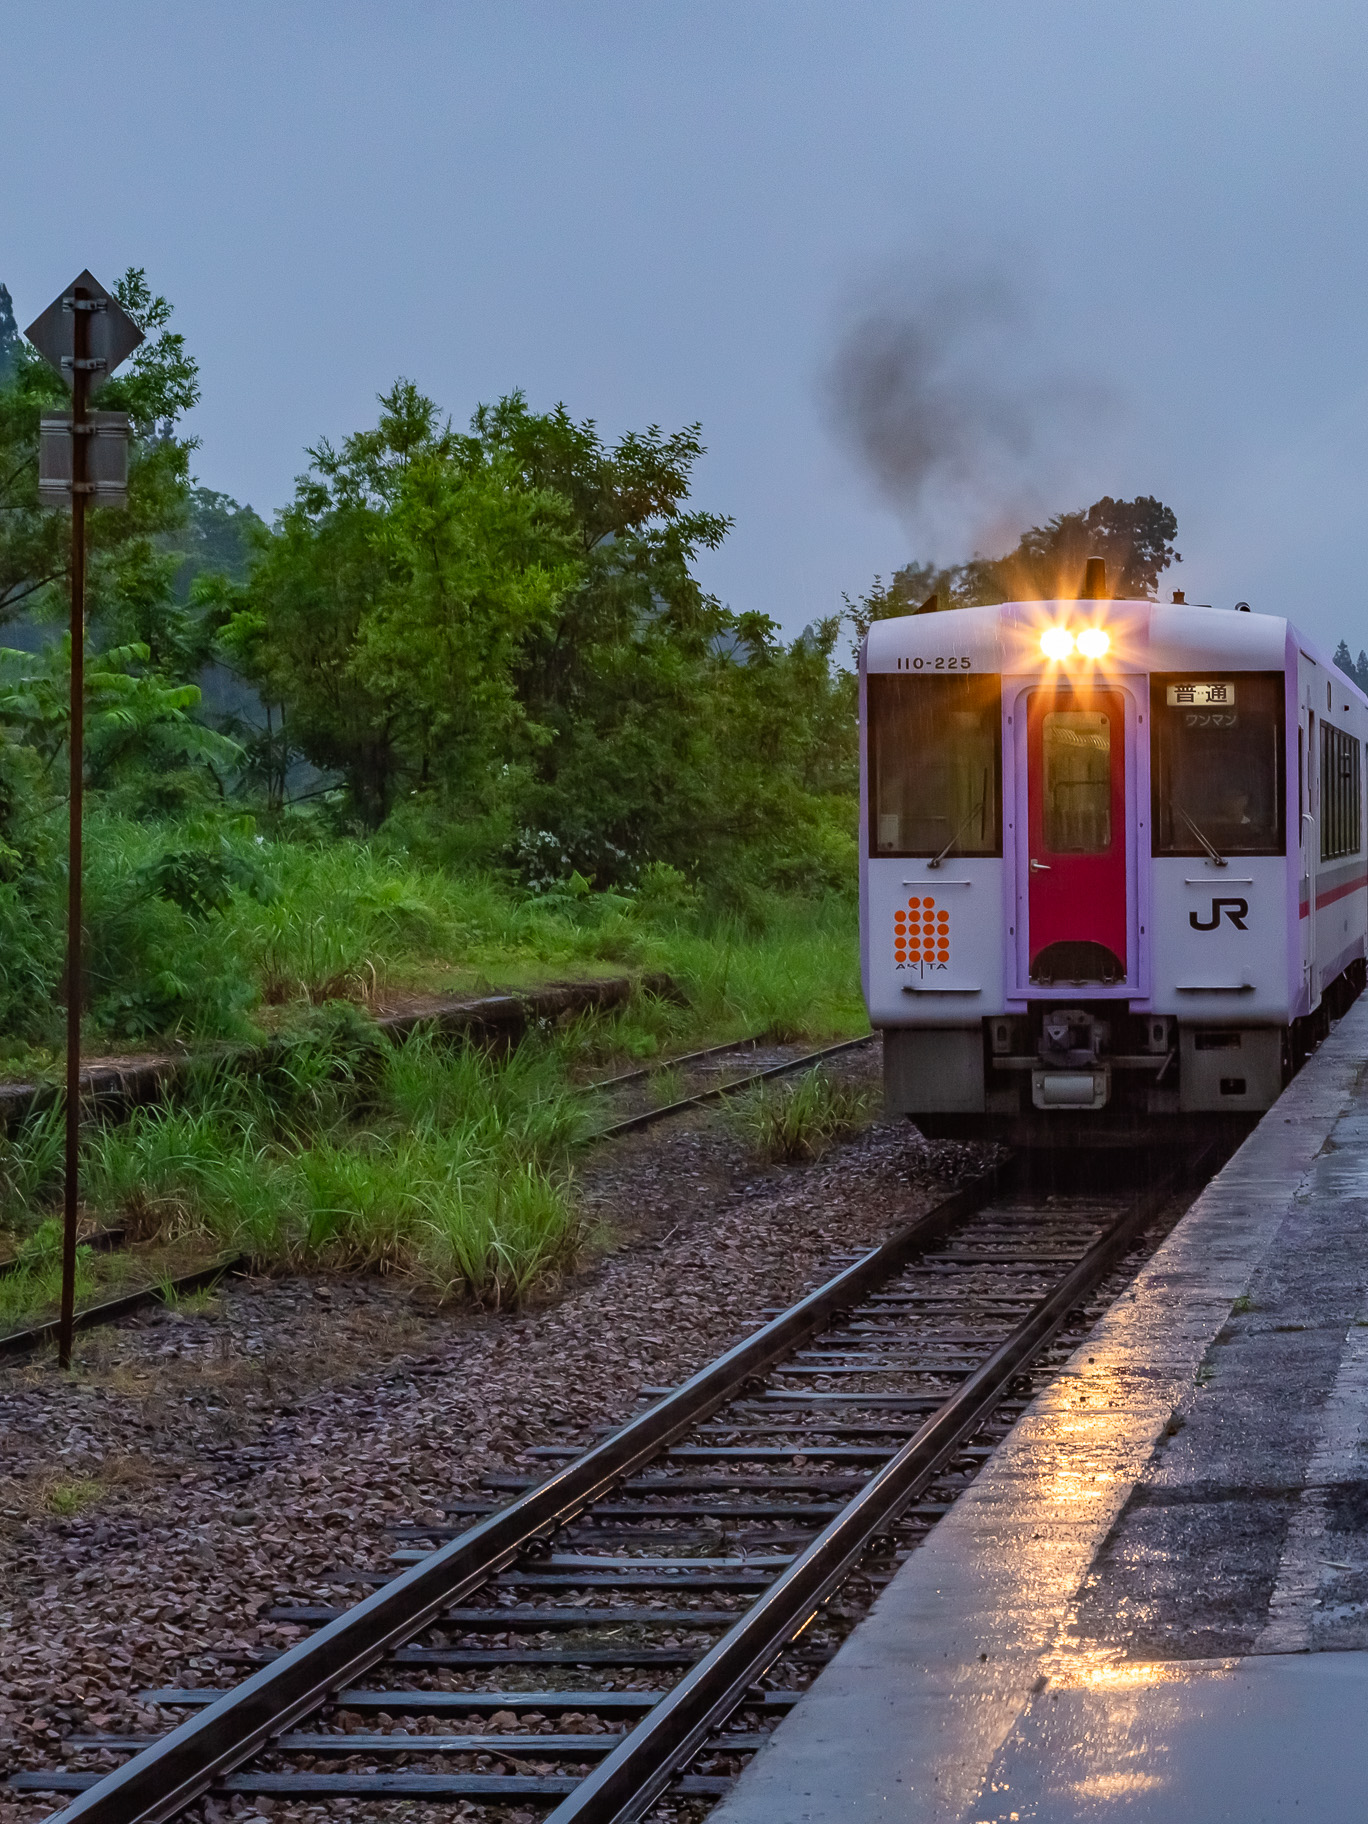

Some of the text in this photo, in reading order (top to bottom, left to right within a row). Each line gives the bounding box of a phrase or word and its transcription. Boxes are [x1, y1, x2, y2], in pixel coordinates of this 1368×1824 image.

[897, 657, 971, 670] 110-225
[1174, 684, 1227, 703] 普通
[1186, 714, 1237, 726] ワンマン
[1189, 897, 1249, 931] JR
[895, 959, 948, 979] AKITA
